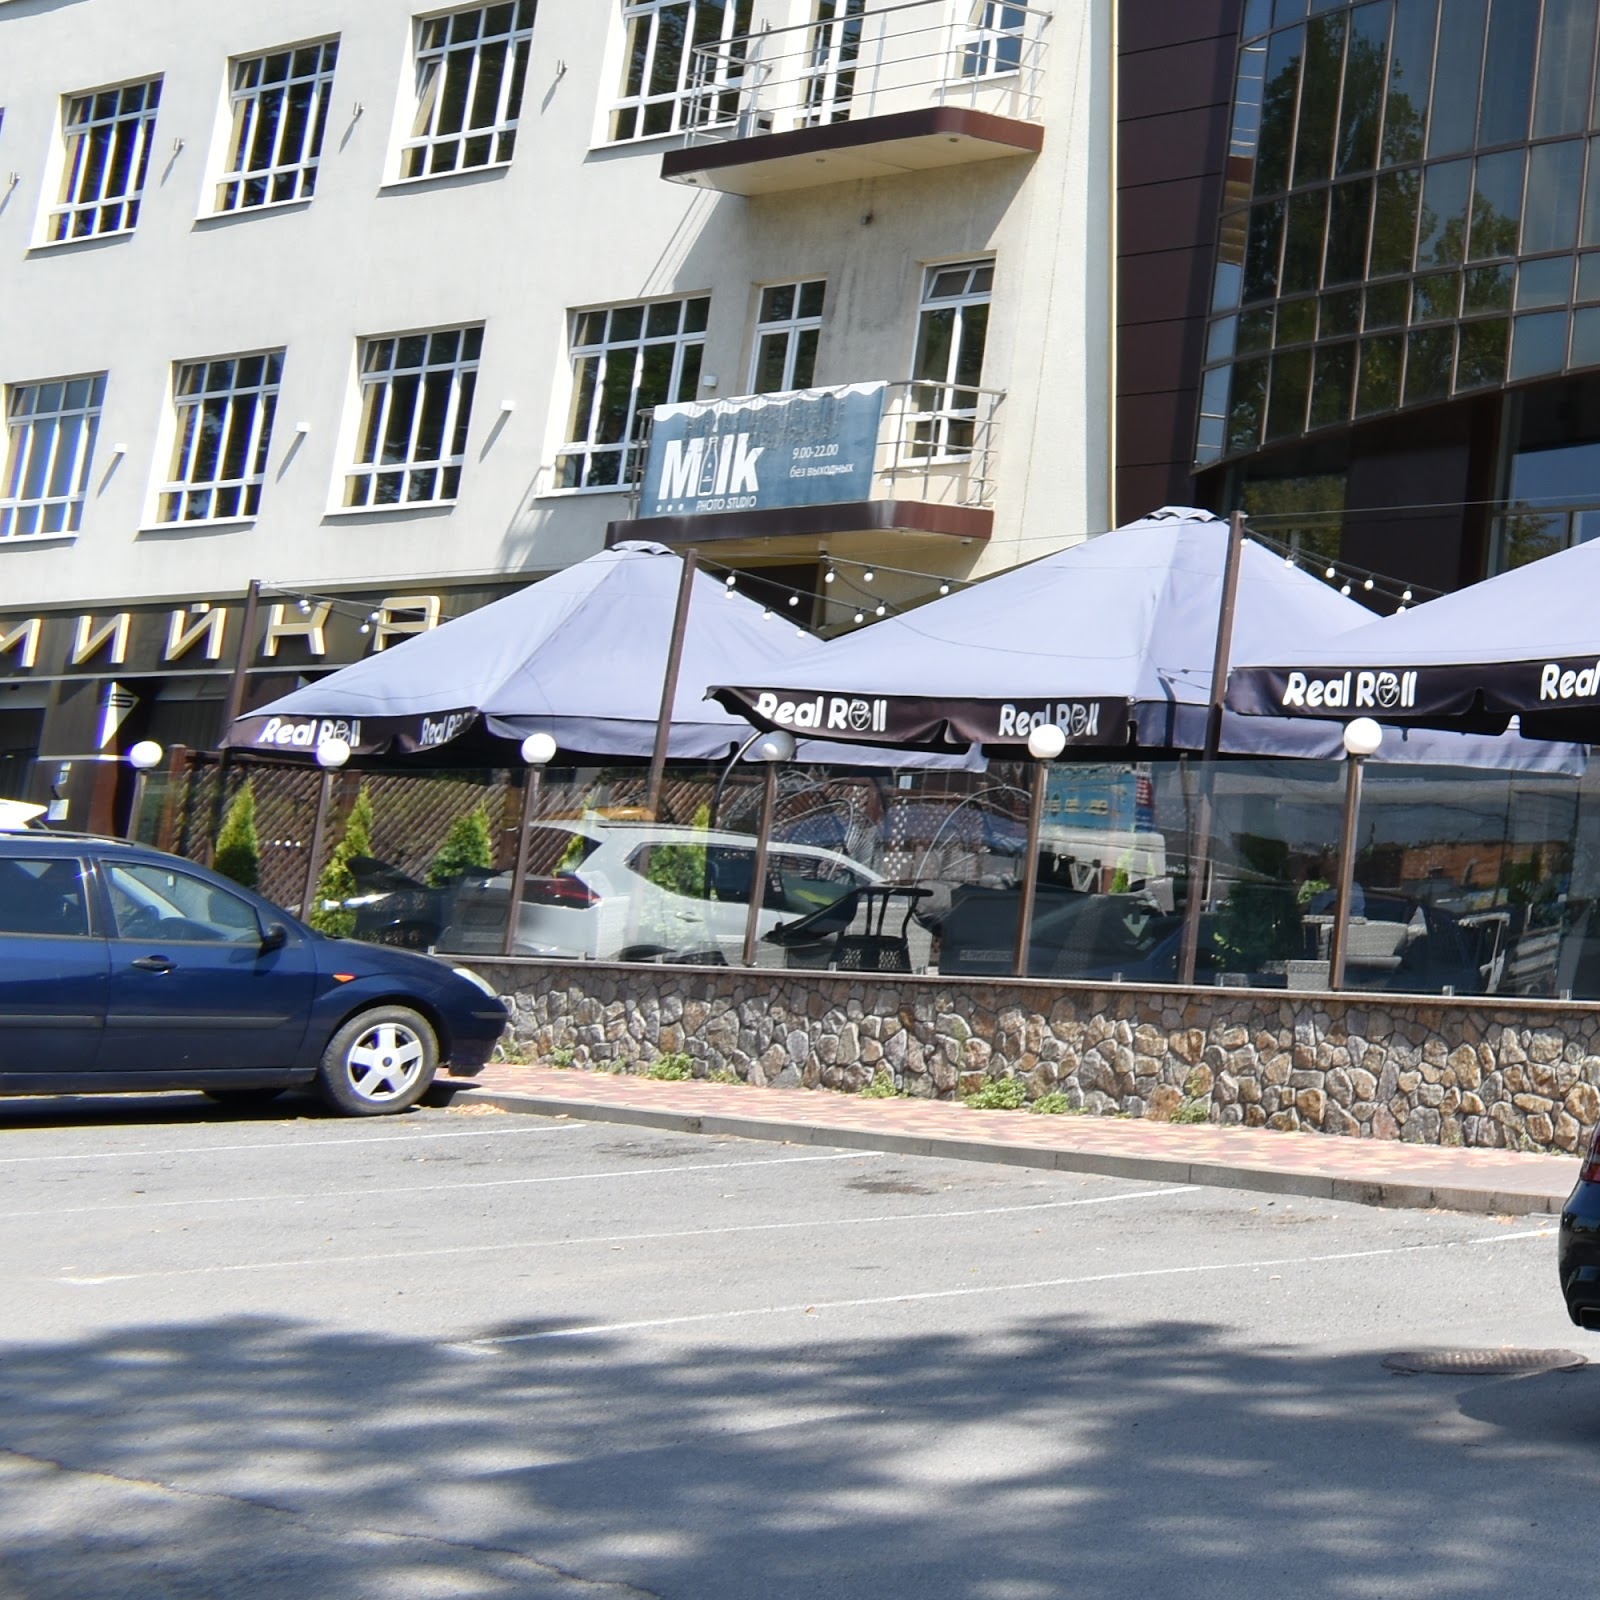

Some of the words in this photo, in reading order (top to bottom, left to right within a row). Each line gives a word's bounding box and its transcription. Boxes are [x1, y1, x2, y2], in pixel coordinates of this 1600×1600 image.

[790, 464, 805, 478] без
[807, 462, 853, 477] выходных
[696, 498, 725, 512] PHOTO
[726, 495, 757, 510] STUDIO
[1283, 672, 1351, 707] Real
[753, 692, 824, 730] Real
[258, 717, 317, 746] Real
[419, 715, 448, 746] Real
